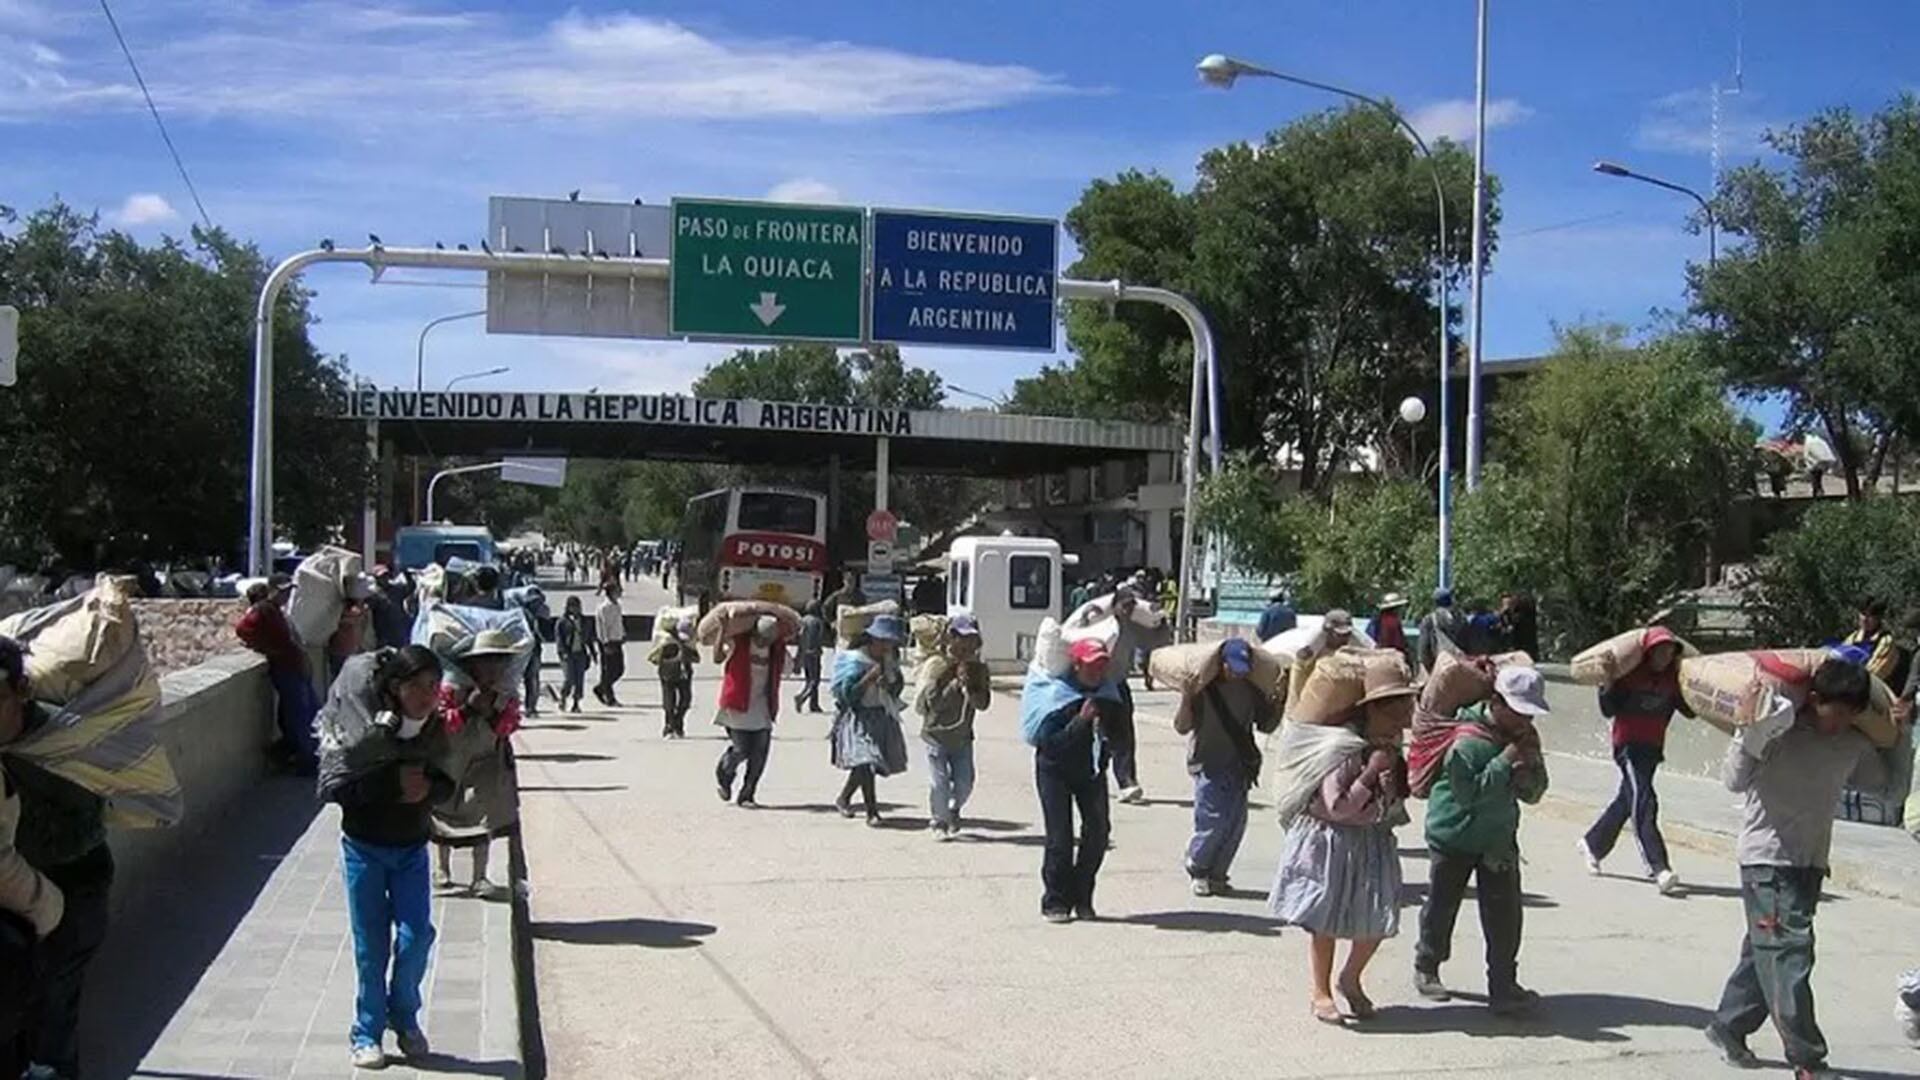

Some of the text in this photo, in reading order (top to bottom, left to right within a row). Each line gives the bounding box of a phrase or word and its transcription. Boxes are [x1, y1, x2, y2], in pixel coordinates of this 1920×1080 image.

[678, 216, 728, 239] PASO
[756, 220, 860, 245] FRONTERA
[907, 230, 1023, 256] BIENVENIDO
[702, 253, 834, 280] LA QUIACA
[880, 267, 1048, 296] A LA REPUBLICA
[909, 306, 1016, 332] ARGENTINA
[510, 393, 527, 419] A
[538, 393, 573, 420] LA
[584, 394, 739, 425] REPUBLICA
[759, 403, 913, 435] ARGENTINA
[737, 541, 814, 562] POTOSI
